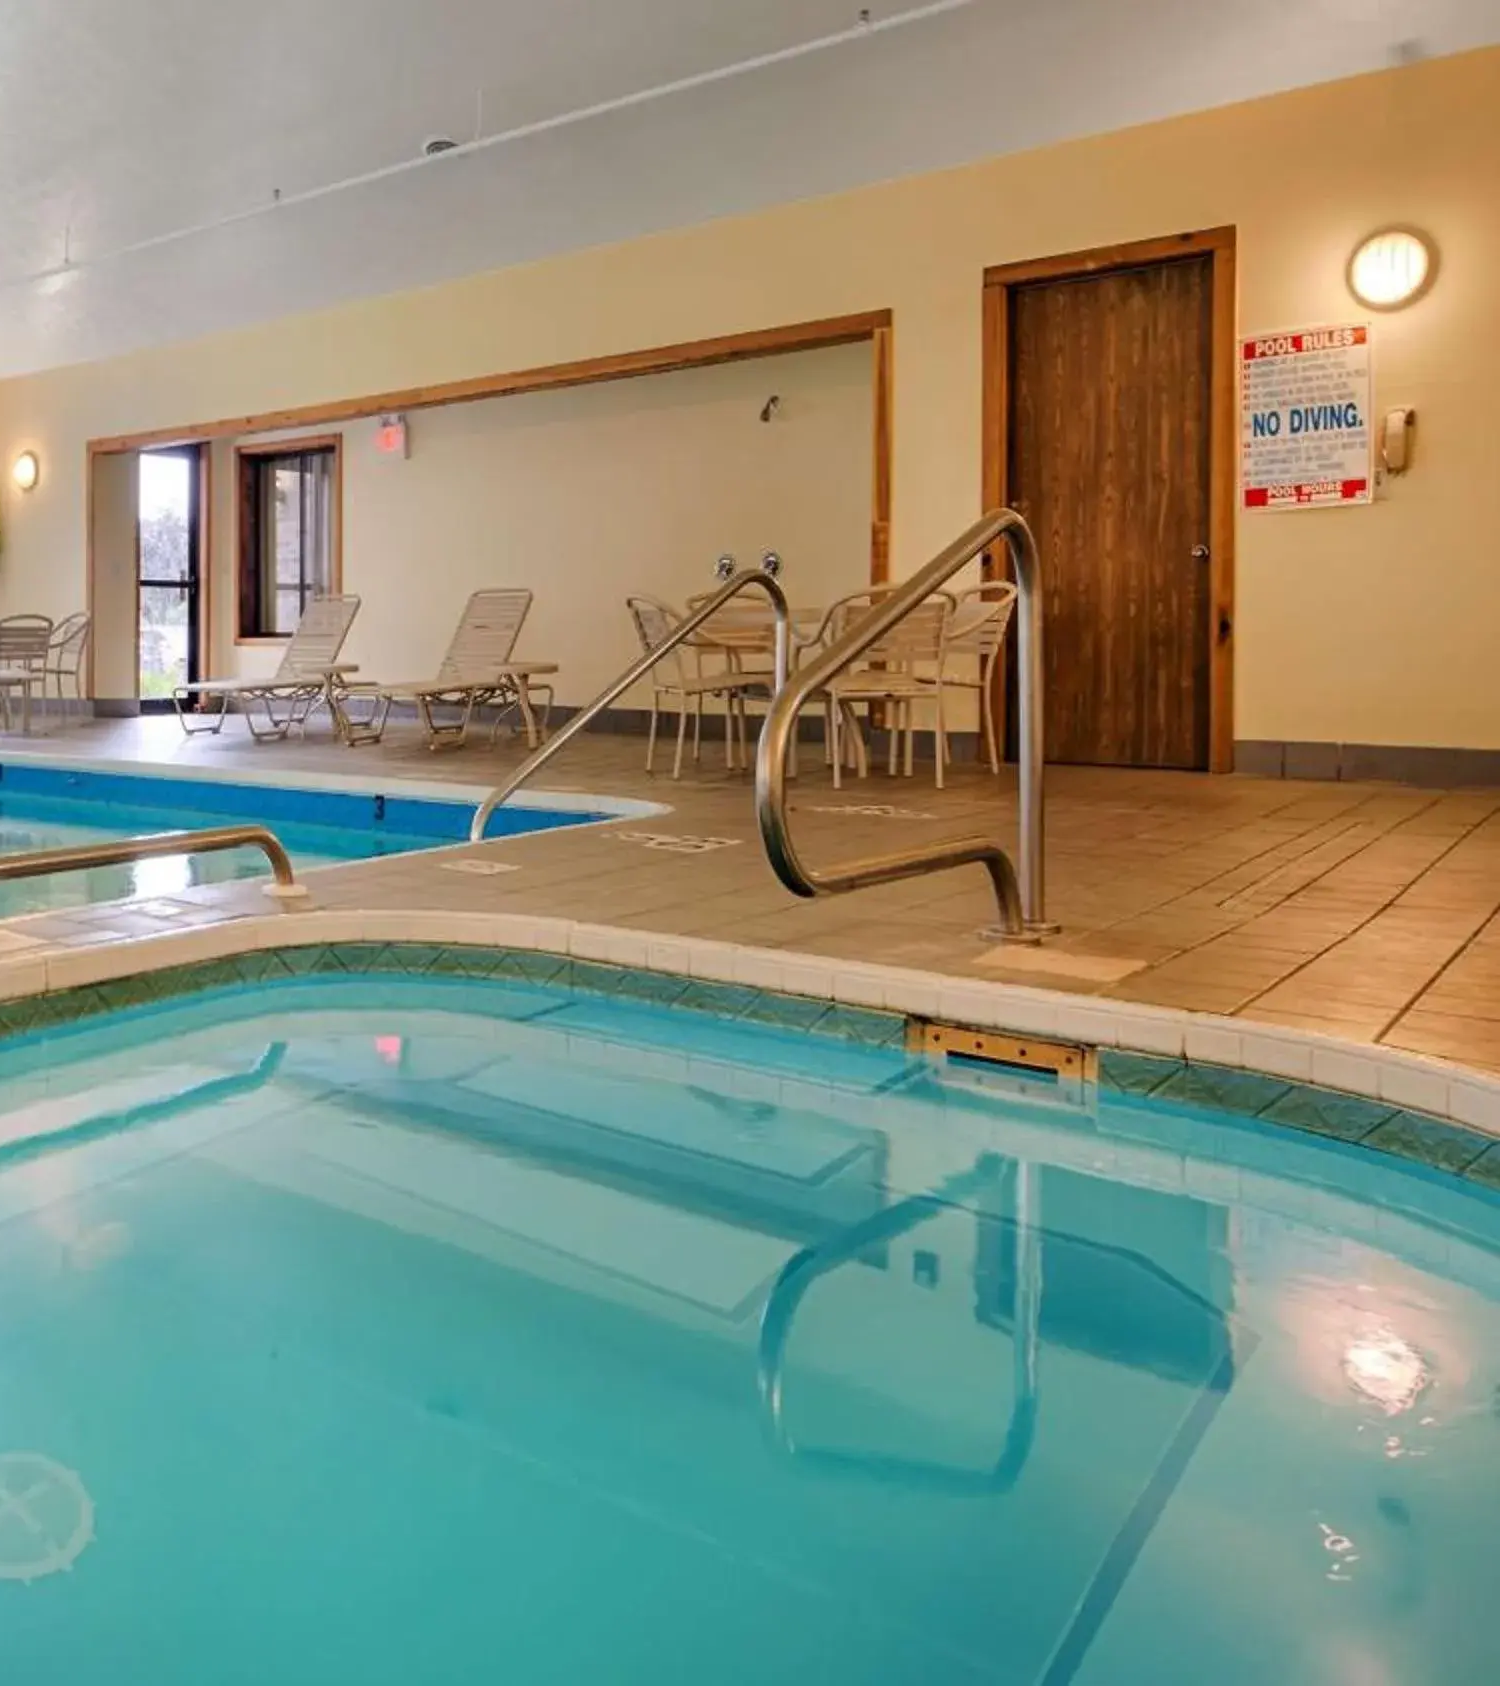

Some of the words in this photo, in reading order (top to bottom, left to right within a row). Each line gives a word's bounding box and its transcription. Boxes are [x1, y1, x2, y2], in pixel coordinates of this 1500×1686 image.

[1255, 336, 1297, 356] POOL
[1302, 329, 1353, 352] RULES
[1252, 411, 1281, 437] NO
[1289, 402, 1363, 434] DIVING.
